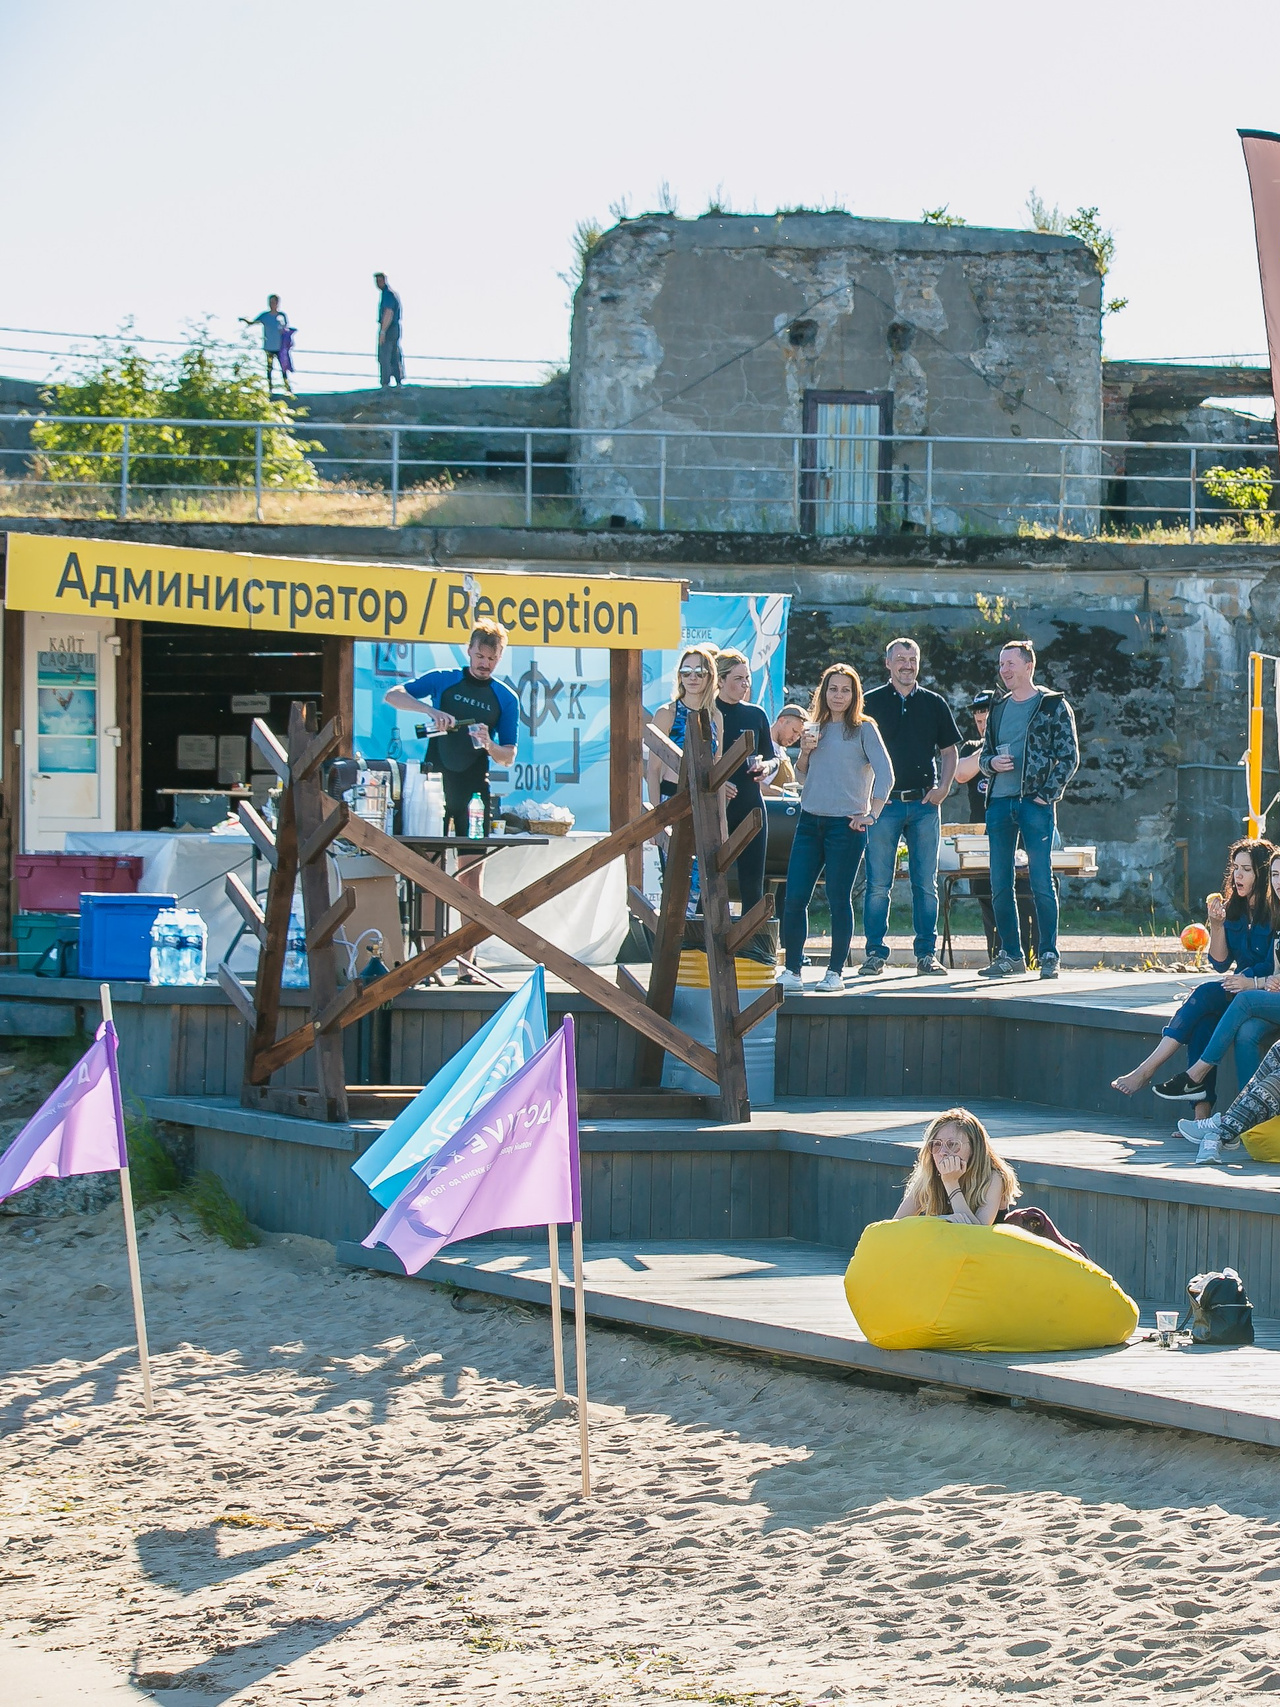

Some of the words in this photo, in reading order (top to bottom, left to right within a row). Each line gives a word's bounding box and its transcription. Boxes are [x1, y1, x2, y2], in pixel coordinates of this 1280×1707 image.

[55, 551, 408, 636] Администратор
[447, 584, 639, 644] Reception
[49, 634, 85, 652] КАЙТ
[454, 693, 491, 711] O'NEILL
[514, 763, 552, 792] 2019
